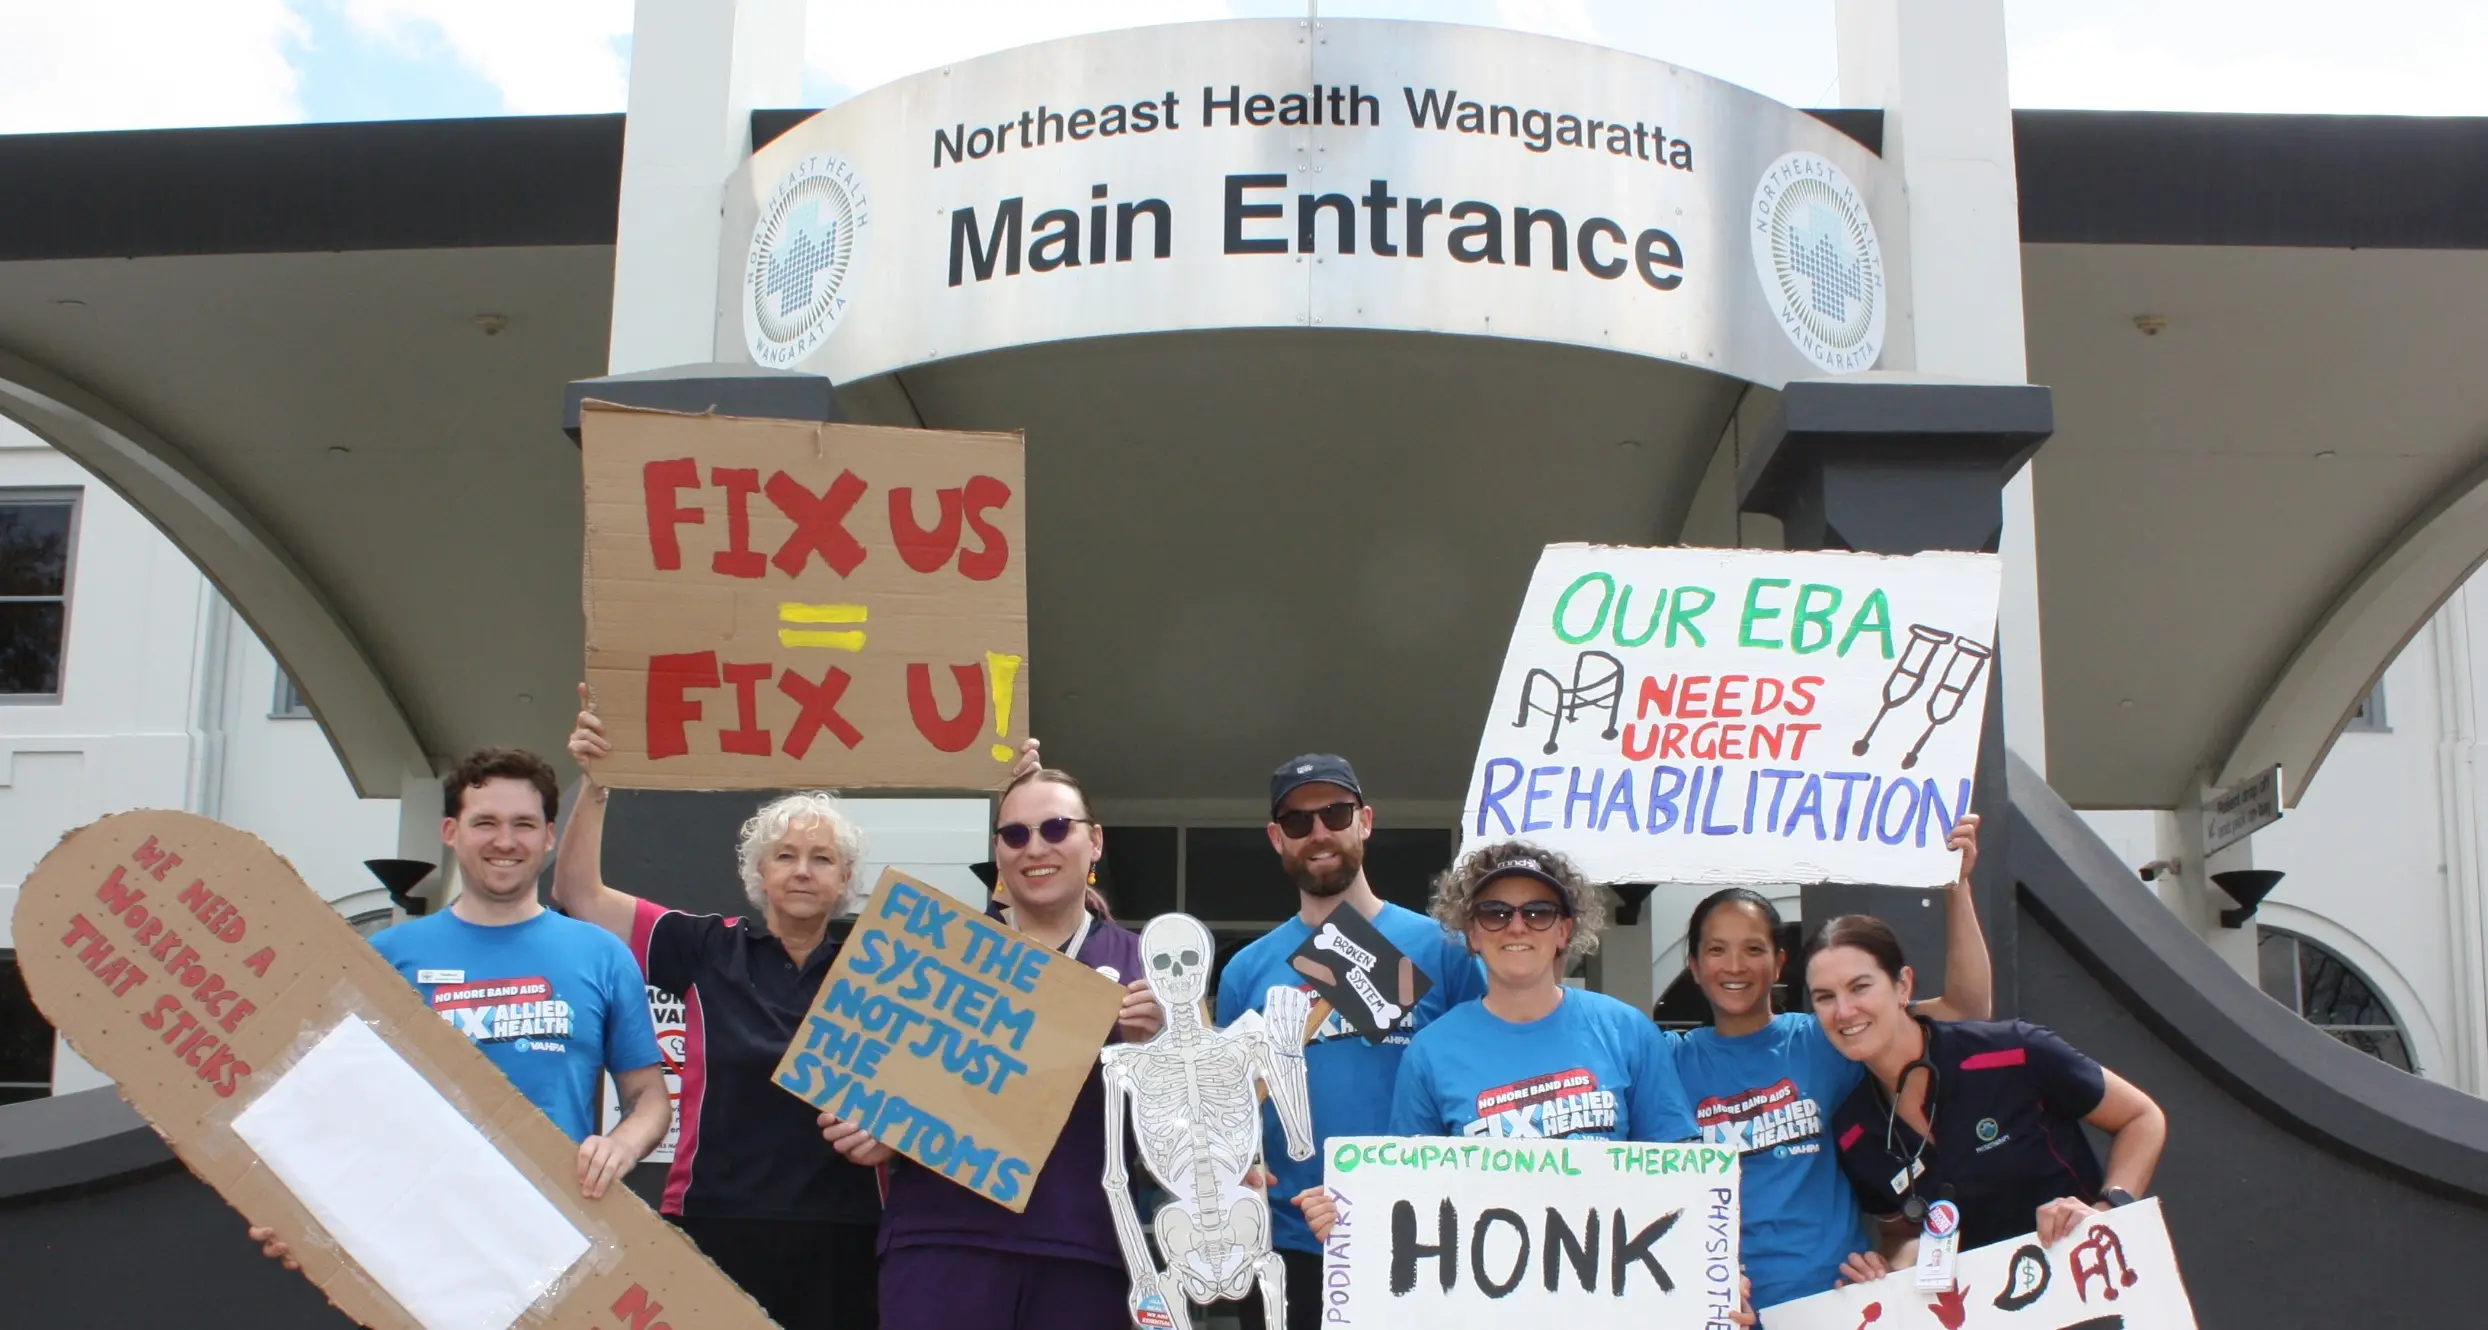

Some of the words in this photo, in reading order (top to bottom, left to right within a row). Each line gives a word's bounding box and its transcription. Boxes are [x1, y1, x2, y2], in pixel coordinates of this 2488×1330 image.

[933, 91, 1180, 168] Northeast
[1203, 84, 1380, 127] Health
[1403, 86, 1694, 172] Wangaratta
[748, 157, 818, 284] NORTHEAST
[826, 156, 868, 228] HEALTH
[948, 183, 1172, 287] Main
[1224, 173, 1684, 292] Entrance
[1756, 158, 1836, 234] NORTHEAST
[1844, 186, 1882, 288] HEALTH
[756, 297, 846, 363] WANGARATTA
[1781, 304, 1875, 369] WANGARATTA
[643, 457, 869, 579] FIX
[888, 474, 1012, 581] US
[1552, 571, 1716, 648] OUR
[1737, 577, 1895, 660] EBA
[646, 649, 864, 761] FIX
[906, 649, 1023, 763] U!
[1636, 674, 1825, 720] NEEDS
[1621, 722, 1822, 761] URGENT
[1476, 757, 1971, 851] REHABILITATION
[132, 835, 183, 882] WE
[178, 878, 246, 943] NEED
[243, 946, 276, 978] A
[880, 882, 956, 949] FIX
[960, 919, 1051, 993] THE
[96, 864, 258, 1034] WORKFORCE
[1332, 935, 1373, 966] BROKEN
[61, 913, 148, 998] THAT
[140, 994, 252, 1097] STICKS
[435, 992, 451, 1003] NO
[453, 988, 485, 1000] MORE
[487, 985, 518, 997] BAND
[520, 984, 546, 994] AIDS
[494, 1001, 569, 1021] ALLIED
[848, 930, 1035, 1050] SYSTEM
[1350, 970, 1385, 1013] SYSTEM
[494, 1018, 569, 1038] HEALTH
[530, 1041, 566, 1053] VAHPA
[804, 1015, 892, 1079] THE
[822, 978, 926, 1045] NOT
[908, 1017, 1028, 1095] JUST
[1478, 1098, 1495, 1109] NO
[1496, 1088, 1528, 1105] MORE
[1530, 1080, 1562, 1096] BAND
[1563, 1076, 1589, 1088] AIDS
[1542, 1091, 1616, 1120] ALLIED
[1542, 1108, 1616, 1137] HEALTH
[1698, 1108, 1712, 1118] NO
[1713, 1104, 1741, 1115] MORE
[1742, 1095, 1768, 1112] BAND
[1769, 1086, 1791, 1103] AIDS
[1752, 1099, 1817, 1134] ALLIED
[779, 1052, 1032, 1203] SYMPTOMS
[1607, 1145, 1736, 1175] THERAPY
[1752, 1116, 1820, 1149] HEALTH
[1327, 1186, 1353, 1324] PODIATRY
[1389, 1195, 1685, 1299] HONK
